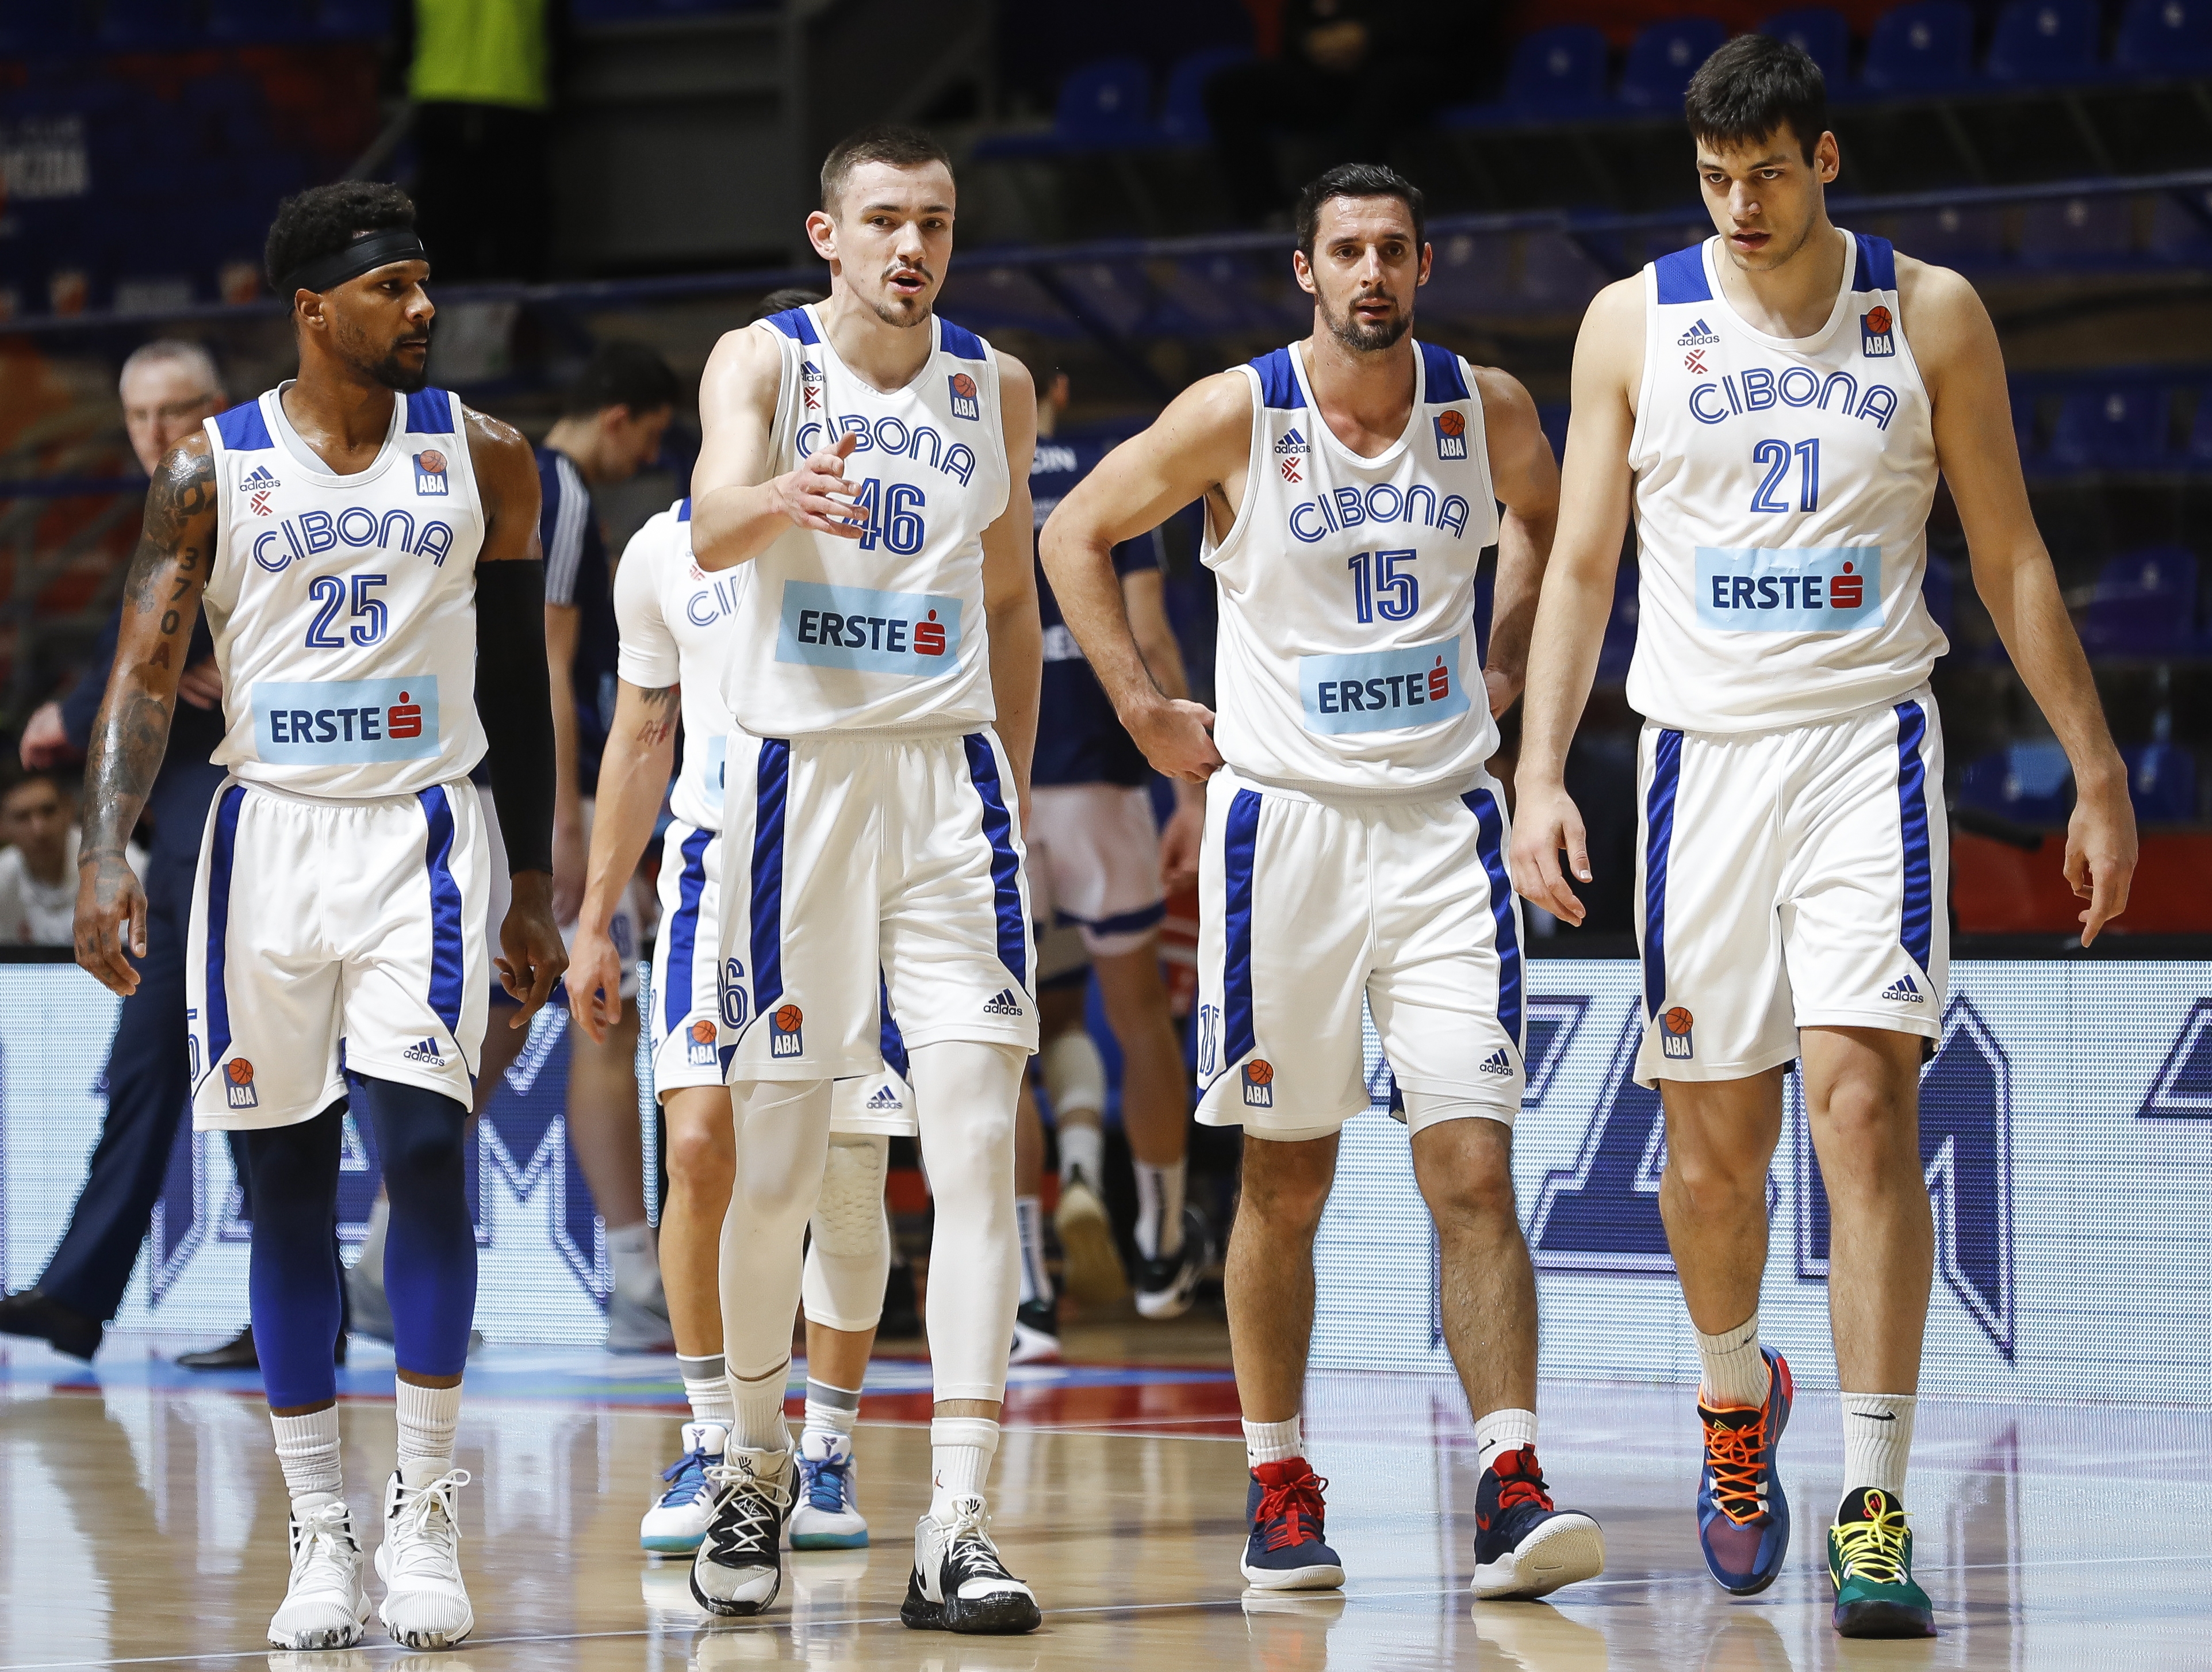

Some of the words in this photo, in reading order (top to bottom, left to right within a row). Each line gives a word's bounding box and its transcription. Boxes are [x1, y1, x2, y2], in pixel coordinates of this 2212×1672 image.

[1677, 331, 1720, 346] adidas
[1865, 335, 1893, 355] ABA
[953, 397, 977, 419] ABA
[1689, 366, 1898, 431] CIBONA
[1274, 442, 1312, 454] adidas
[1440, 437, 1465, 458] ABA
[239, 477, 281, 492] adidas
[419, 474, 447, 495] ABA
[1750, 438, 1820, 513] 21
[841, 477, 926, 556] 46
[1289, 483, 1470, 543] CIBONA
[253, 506, 454, 573] CIBONA
[1347, 549, 1420, 624] 15
[1712, 575, 1824, 610] ERSTE
[305, 573, 388, 649] 25
[798, 609, 907, 654] ERSTE
[1318, 672, 1425, 714] ERSTE
[270, 707, 381, 744] ERSTE
[718, 957, 747, 1030] 6
[1881, 990, 1925, 1004] adidas
[983, 1001, 1023, 1017] adidas
[690, 1044, 716, 1065] ABA
[774, 1034, 800, 1055] ABA
[1665, 1036, 1690, 1057] ABA
[403, 1048, 445, 1068] adidas
[1479, 1062, 1514, 1077] adidas
[229, 1086, 255, 1106] ABA
[867, 1098, 903, 1110] adidas
[1245, 1085, 1271, 1105] ABA
